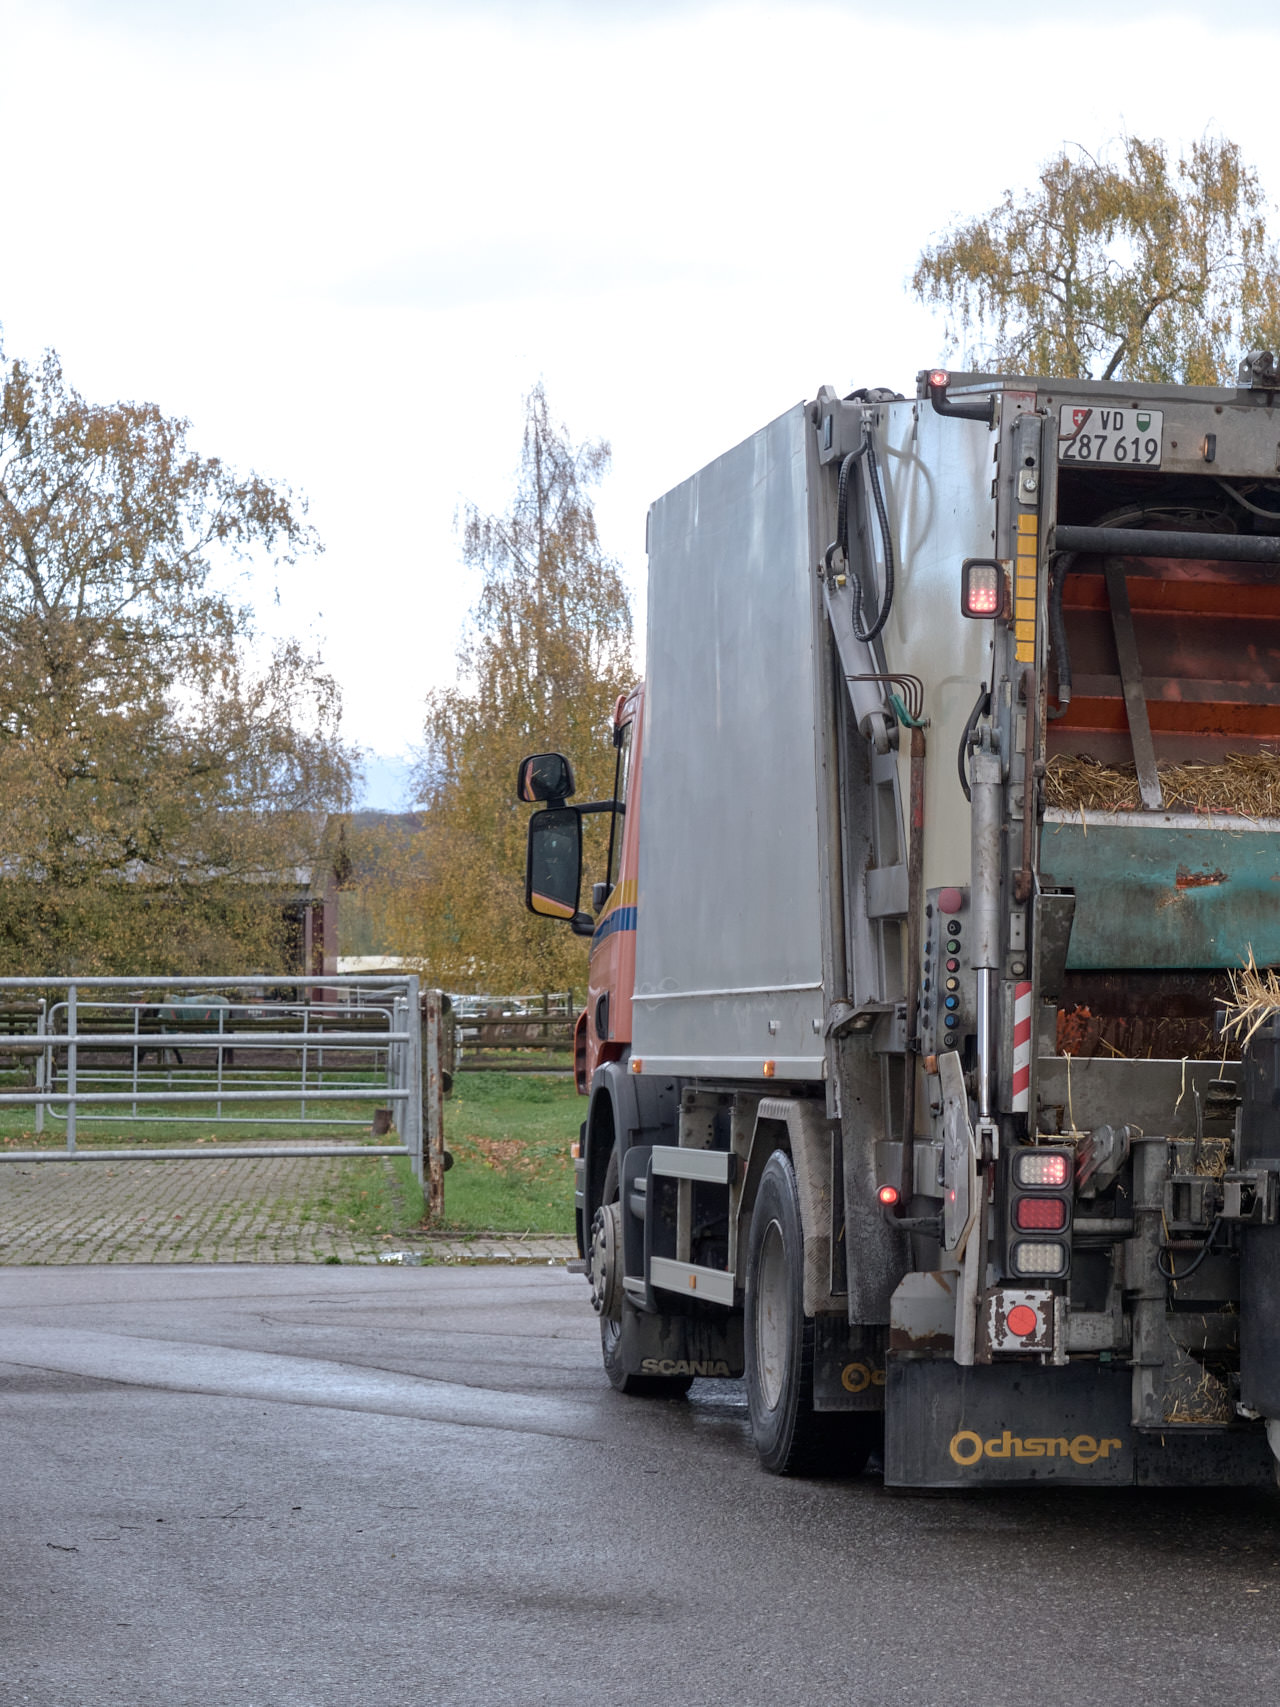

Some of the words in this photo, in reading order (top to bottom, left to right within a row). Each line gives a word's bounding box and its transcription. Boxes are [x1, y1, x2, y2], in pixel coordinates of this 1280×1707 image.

[1101, 411, 1123, 431] VD
[641, 1358, 730, 1375] SCANIA
[950, 1430, 1122, 1465] Ochsner
